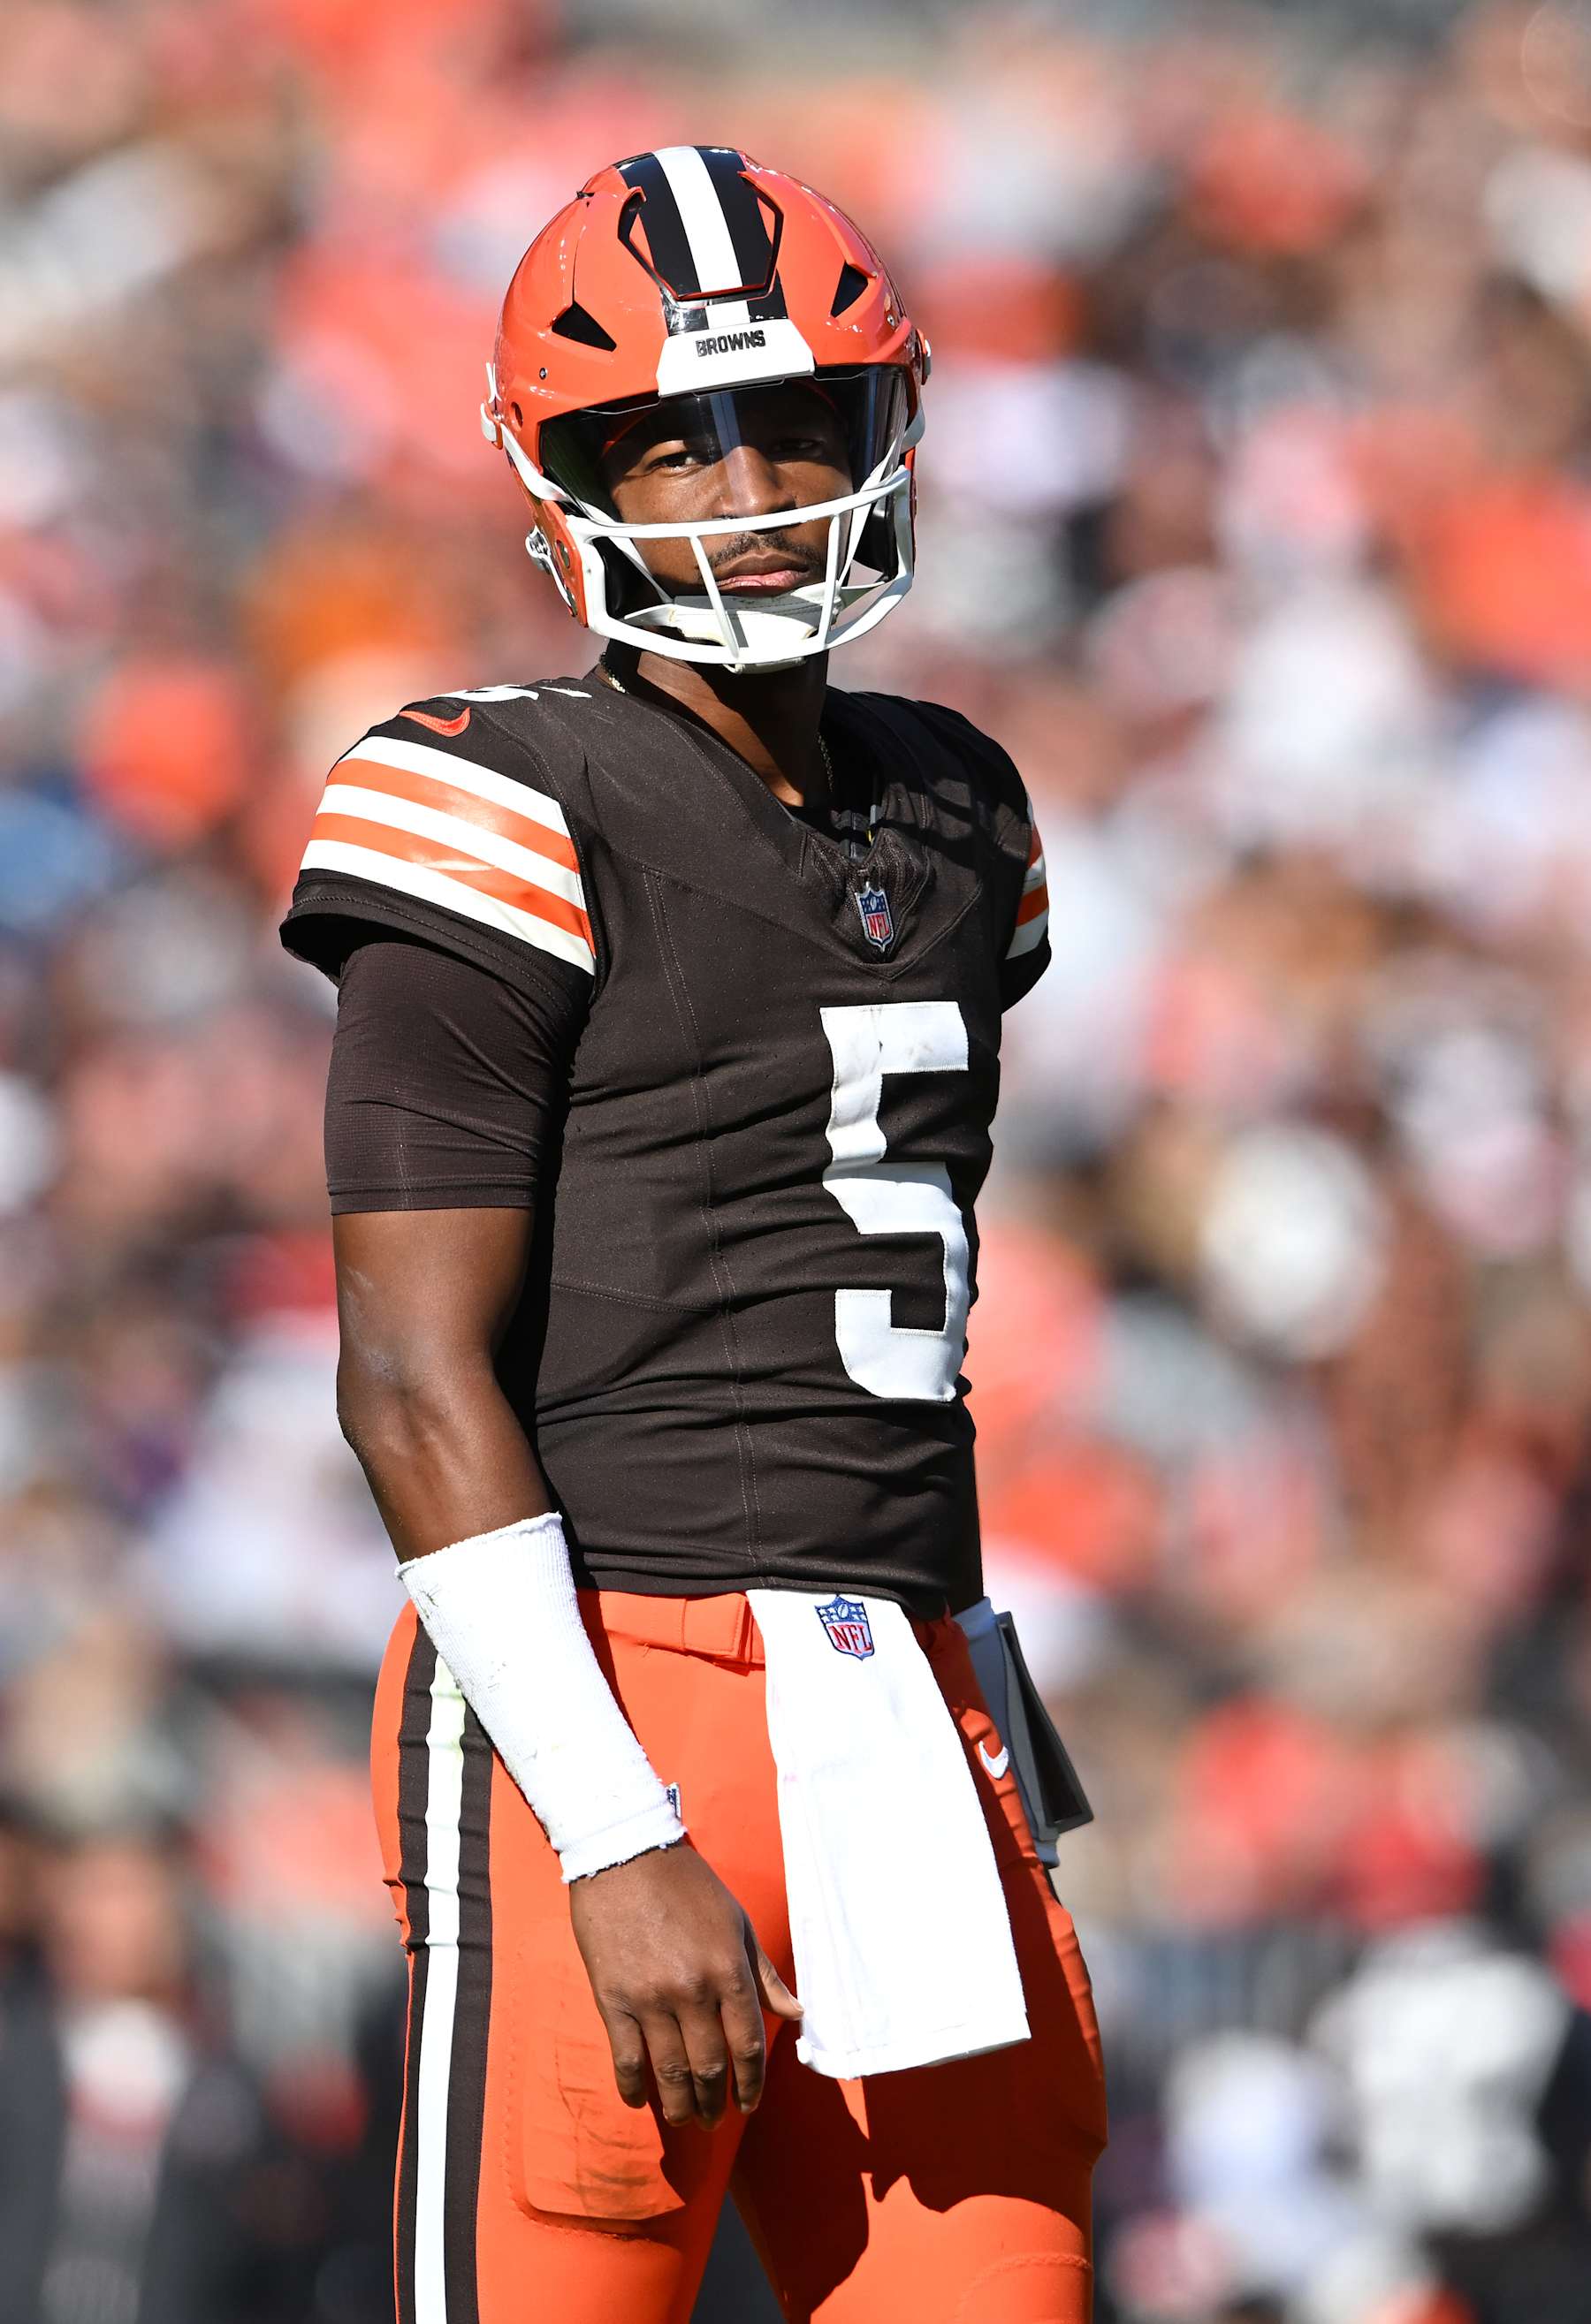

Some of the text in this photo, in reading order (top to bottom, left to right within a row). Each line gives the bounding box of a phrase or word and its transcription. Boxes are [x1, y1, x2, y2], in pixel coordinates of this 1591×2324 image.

[696, 330, 766, 357] BROWNS
[867, 914, 890, 938] NFL
[820, 1001, 969, 1401] 5
[828, 1624, 872, 1654] NFL
